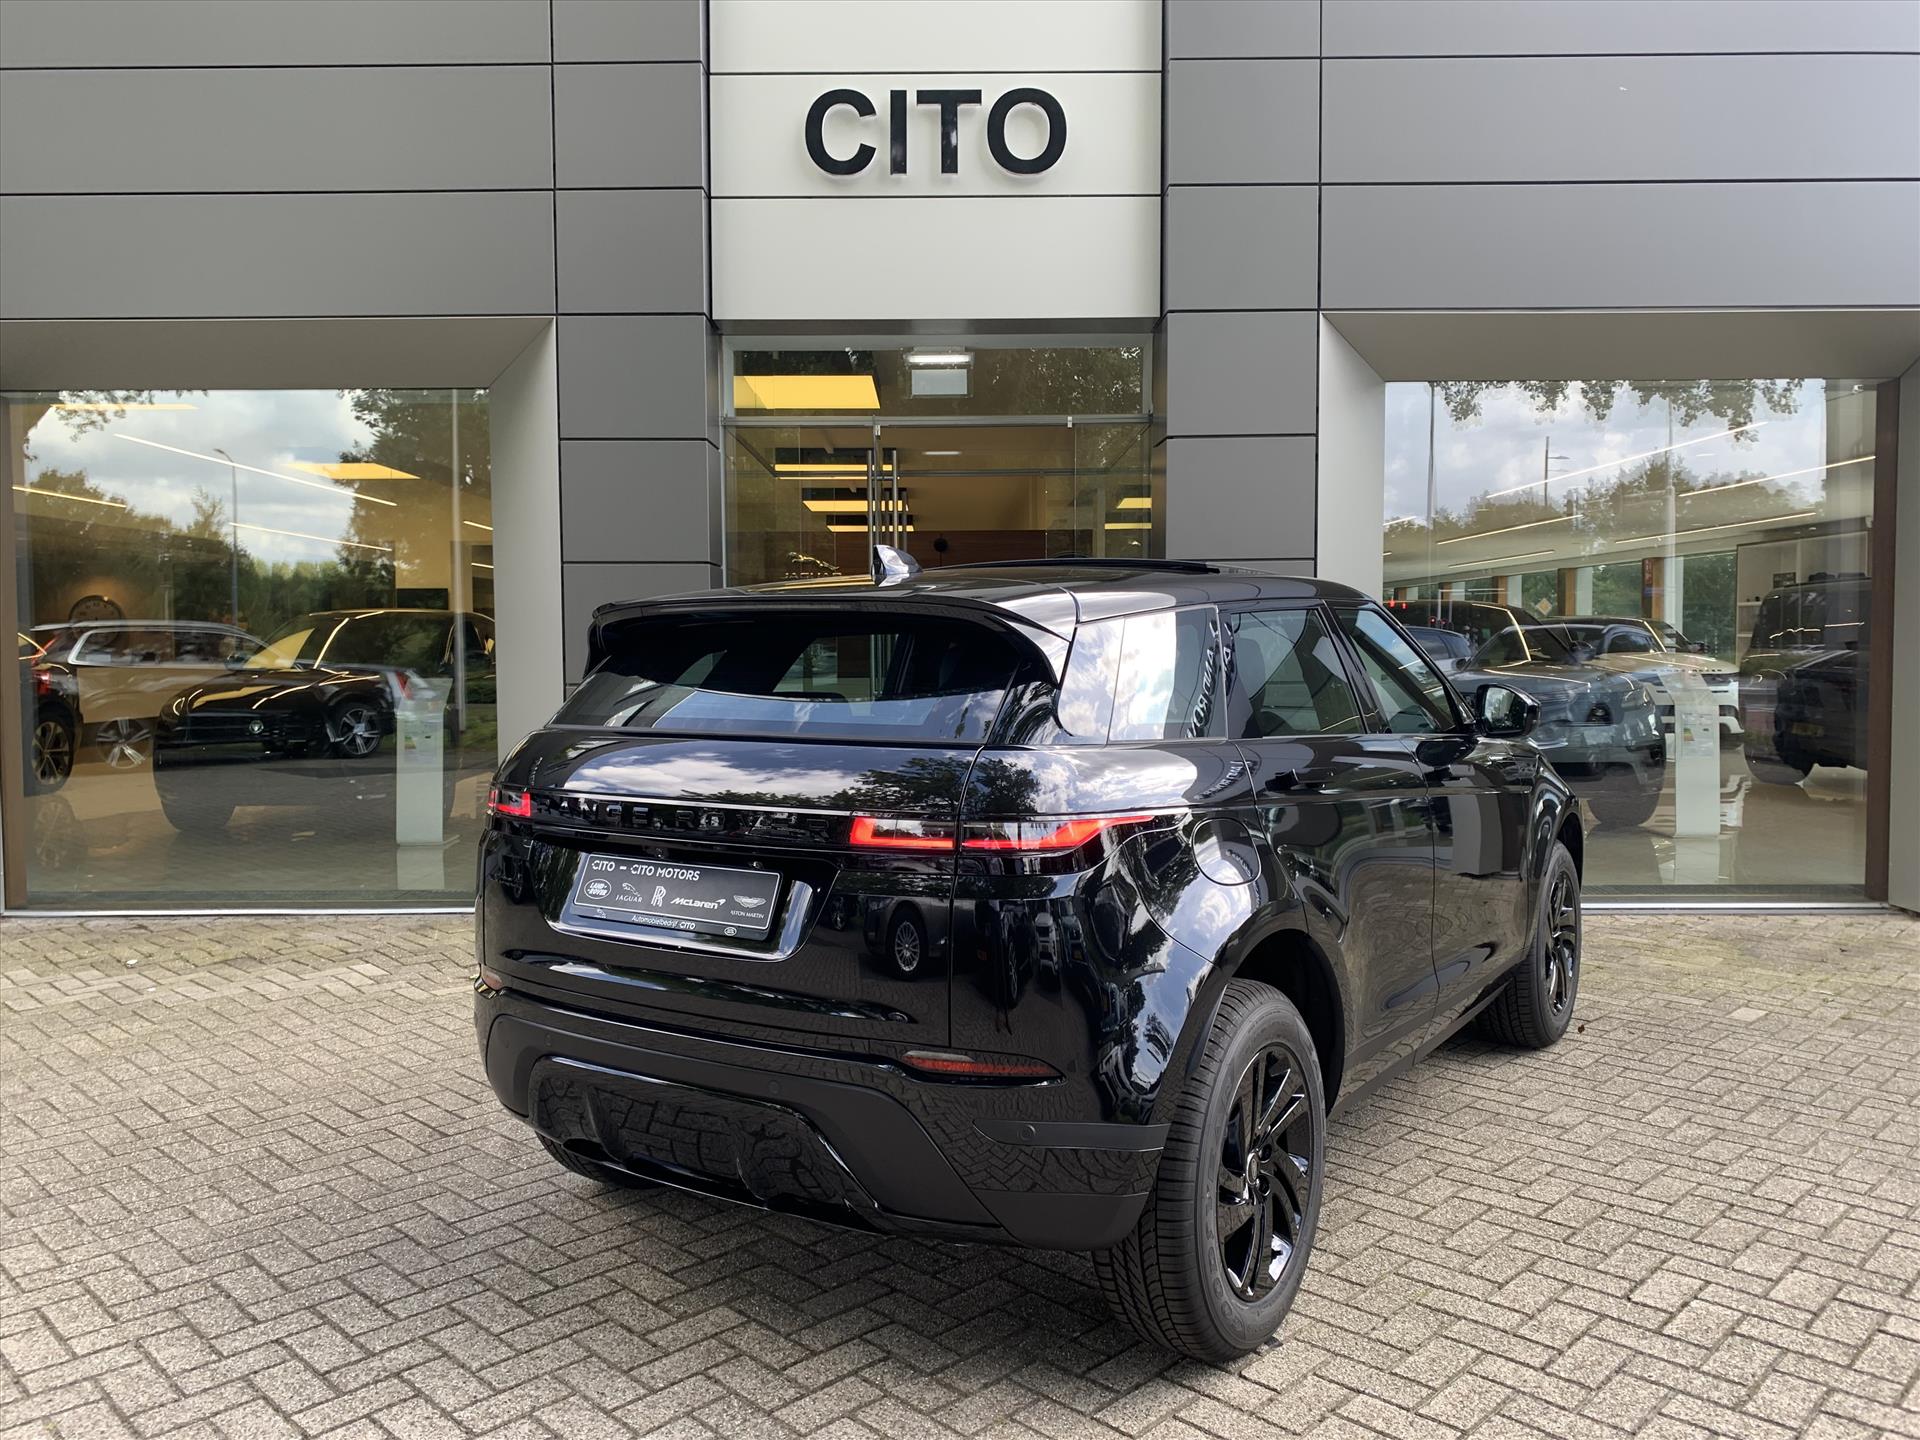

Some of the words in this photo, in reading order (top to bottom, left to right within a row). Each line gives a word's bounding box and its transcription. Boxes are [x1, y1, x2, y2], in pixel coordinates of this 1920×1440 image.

[805, 88, 1067, 176] CITO
[592, 860, 616, 872] CITO
[630, 864, 655, 877] CITO
[656, 867, 701, 881] MOTORS
[615, 894, 643, 903] JAGUAR
[679, 921, 696, 930] CITO
